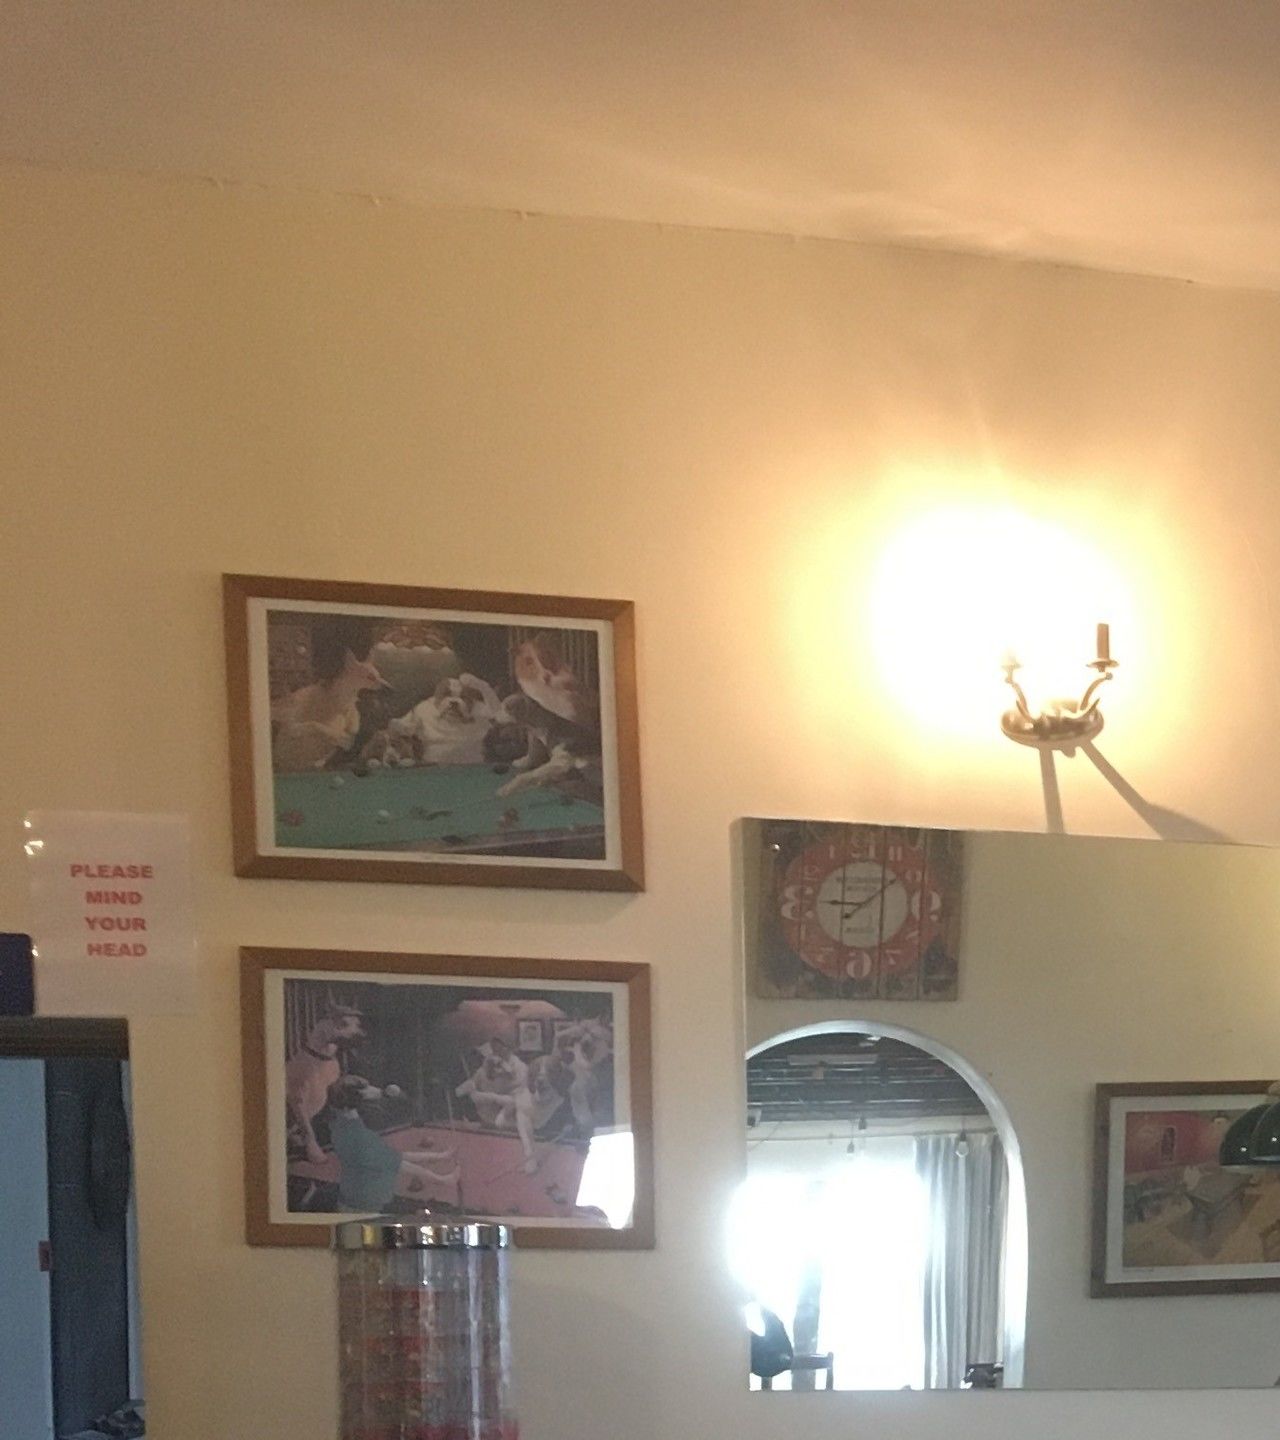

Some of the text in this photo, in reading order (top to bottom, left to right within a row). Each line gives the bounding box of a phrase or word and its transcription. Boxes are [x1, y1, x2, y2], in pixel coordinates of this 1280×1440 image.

[70, 864, 153, 879] PLEASE
[85, 891, 143, 905] MIND
[84, 917, 147, 931] YOUR
[87, 943, 147, 957] HEAD
